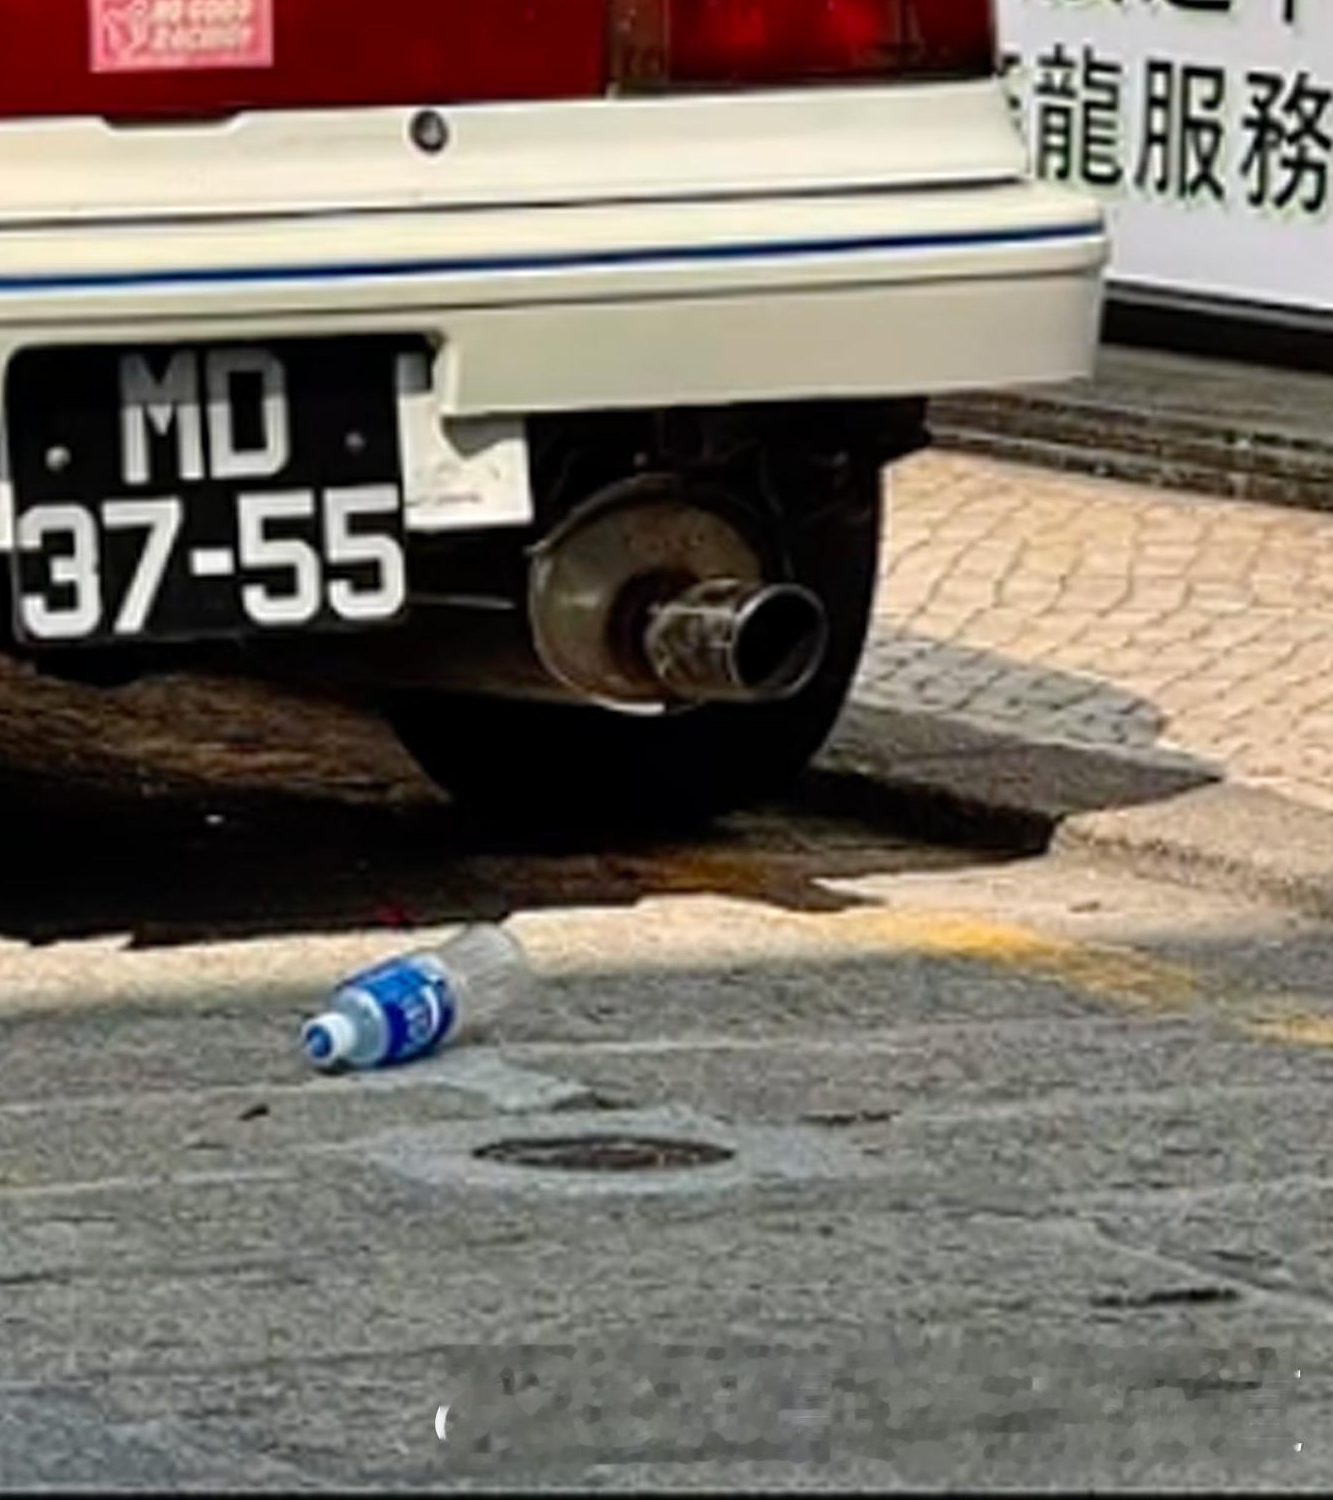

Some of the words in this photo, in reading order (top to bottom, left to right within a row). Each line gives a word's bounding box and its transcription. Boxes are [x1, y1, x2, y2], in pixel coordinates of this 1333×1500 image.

[998, 45, 1333, 214] 龍服務
[120, 347, 290, 484] MD
[17, 484, 406, 639] 37-55
